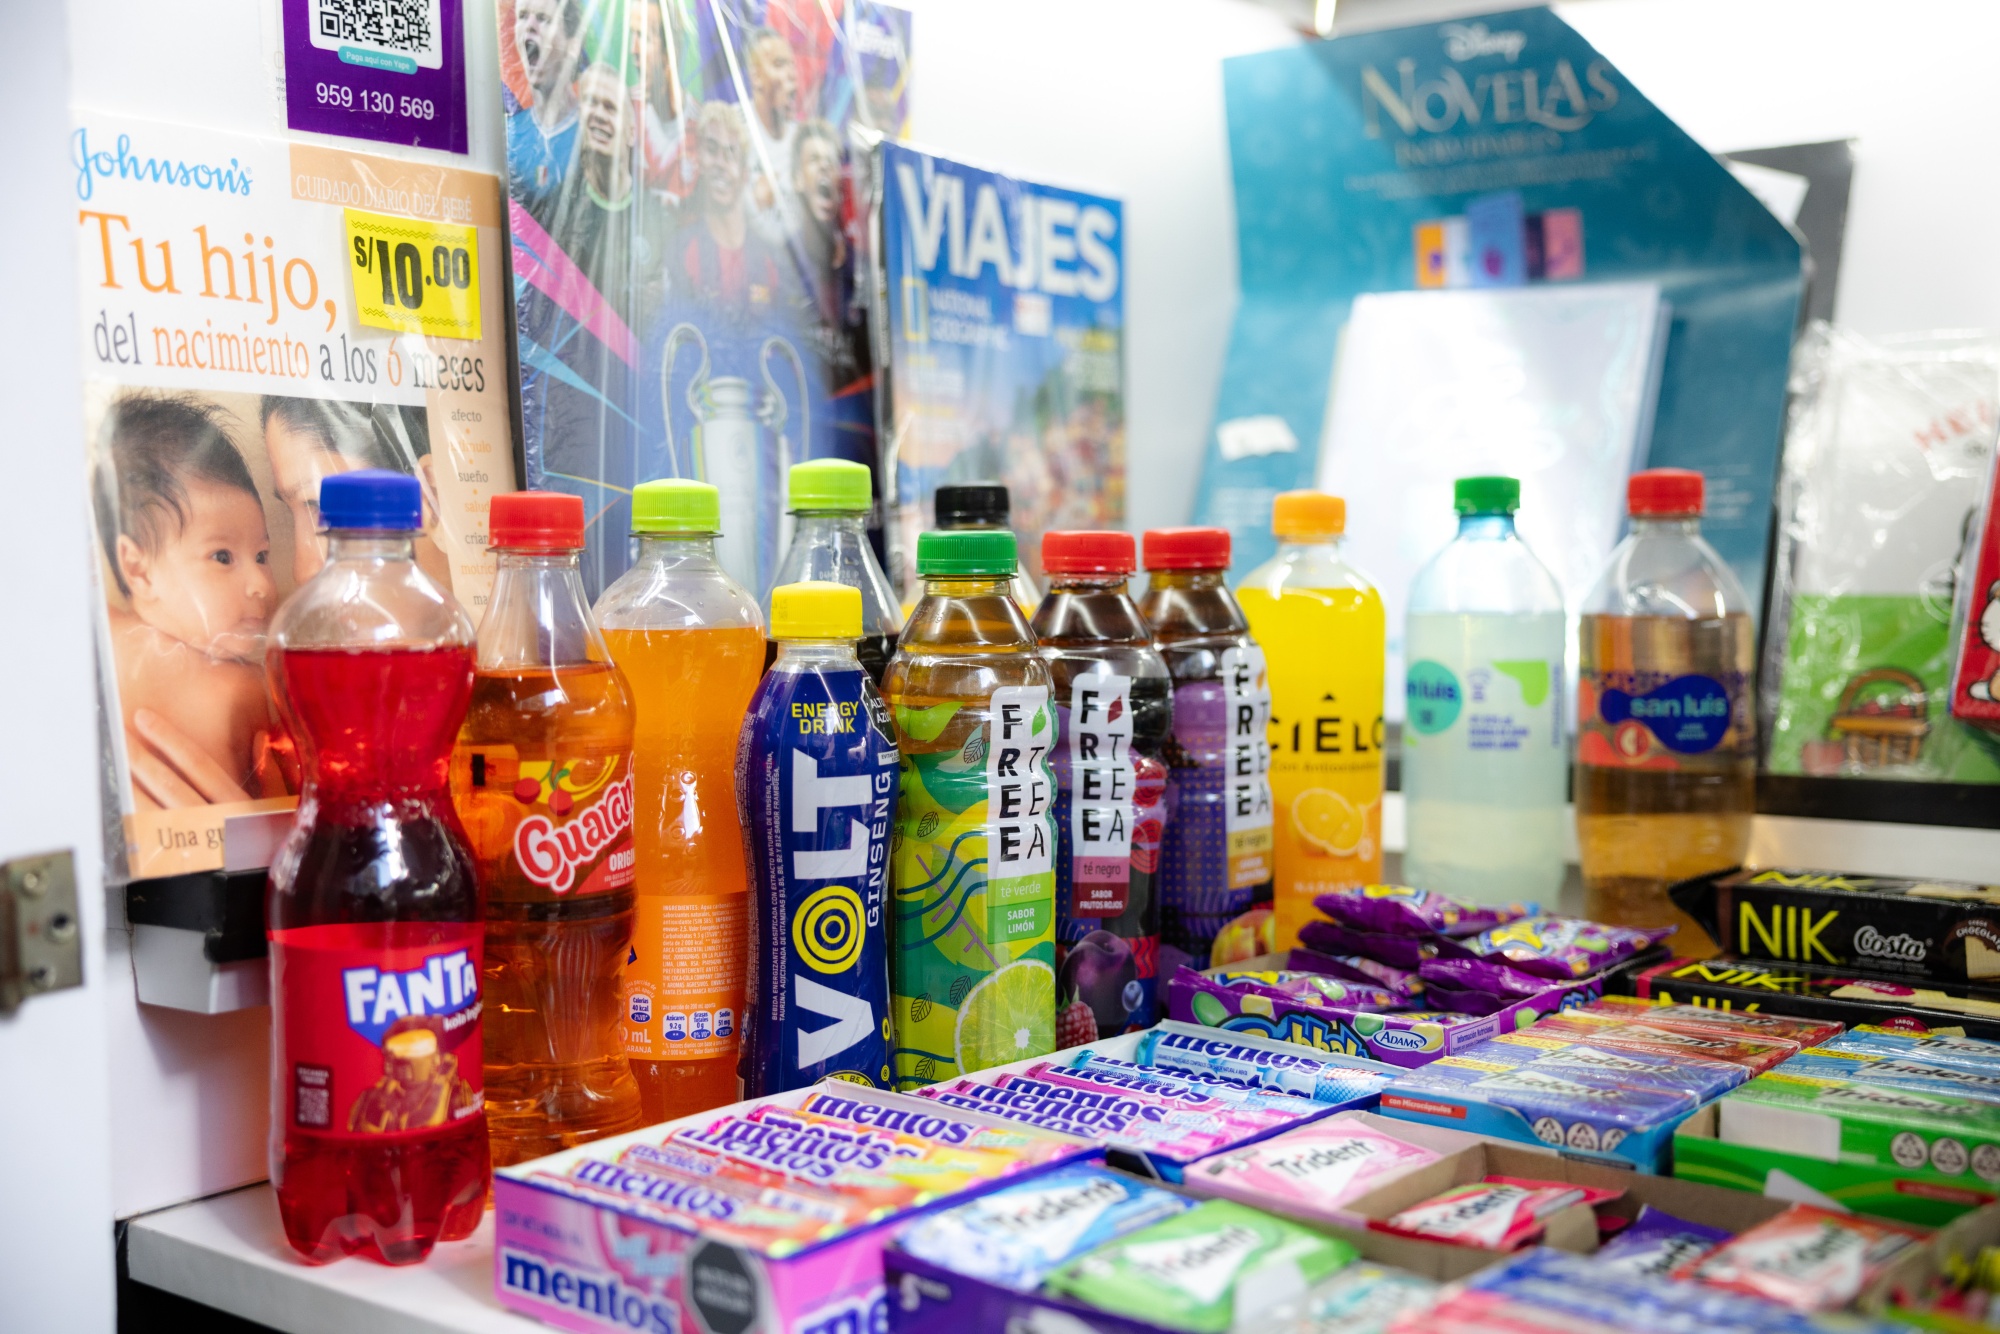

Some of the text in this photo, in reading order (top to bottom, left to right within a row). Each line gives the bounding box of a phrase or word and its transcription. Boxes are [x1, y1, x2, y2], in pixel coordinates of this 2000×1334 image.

[346, 51, 410, 71] Paga aquí con Yape
[316, 82, 435, 120] 959 130 569
[1361, 57, 1619, 139] NOVELAS
[71, 128, 253, 200] Johnson's
[296, 174, 473, 221] CUIDADO DIARIO DEL BEBÉ
[896, 163, 1119, 302] VIAJES
[79, 209, 337, 333] Tu hijo,
[94, 310, 485, 393] del nacimiento a los 6 meses
[451, 409, 482, 423] afecto
[458, 470, 489, 484] sueño
[791, 701, 859, 718] ENERGY
[1630, 692, 1728, 718] san luis
[799, 717, 855, 734] DRINK
[1233, 662, 1253, 816] FREE
[766, 750, 774, 782] CAFEÍNA,
[997, 703, 1023, 863] FREE
[1079, 690, 1101, 842] FREE
[765, 782, 773, 816] GINSENG,
[1027, 746, 1045, 860] TEA
[1107, 733, 1125, 842] TEA
[157, 827, 198, 850] Una
[514, 752, 635, 893] Guaran
[766, 817, 772, 826] DE
[766, 828, 774, 857] NATURAL
[867, 770, 891, 928] GINSENG
[769, 858, 777, 890] EXTRACTO
[1083, 863, 1121, 879] té negro
[1000, 880, 1041, 898] té verde
[1079, 899, 1123, 910] FRUTOS ROJOS
[1091, 889, 1113, 900] SABOR
[791, 747, 875, 1069] VOLT
[1007, 907, 1035, 921] SABOR
[780, 937, 786, 945] DE
[1008, 918, 1035, 934] LIMÓN
[1739, 901, 1841, 965] NIK
[1854, 925, 1927, 961] Costa
[343, 949, 478, 1025] FANTA
[779, 990, 787, 1022] TAURINA,
[1894, 1018, 1914, 1027] SABOR
[625, 1044, 652, 1054] ARANJA
[631, 1028, 652, 1043] mL
[1381, 1030, 1421, 1049] ADAMS
[1456, 1029, 1477, 1044] Información
[1160, 1032, 1326, 1076] mentos
[1541, 1049, 1679, 1074] Trident
[967, 1085, 1133, 1133] mentos
[1004, 1077, 1169, 1122] mentos
[1389, 1098, 1401, 1106] con
[808, 1094, 973, 1145] mentos
[722, 1119, 885, 1170] mentos
[1269, 1138, 1376, 1180] Trident
[576, 1159, 735, 1221] mentos
[506, 1252, 677, 1334] mentos
